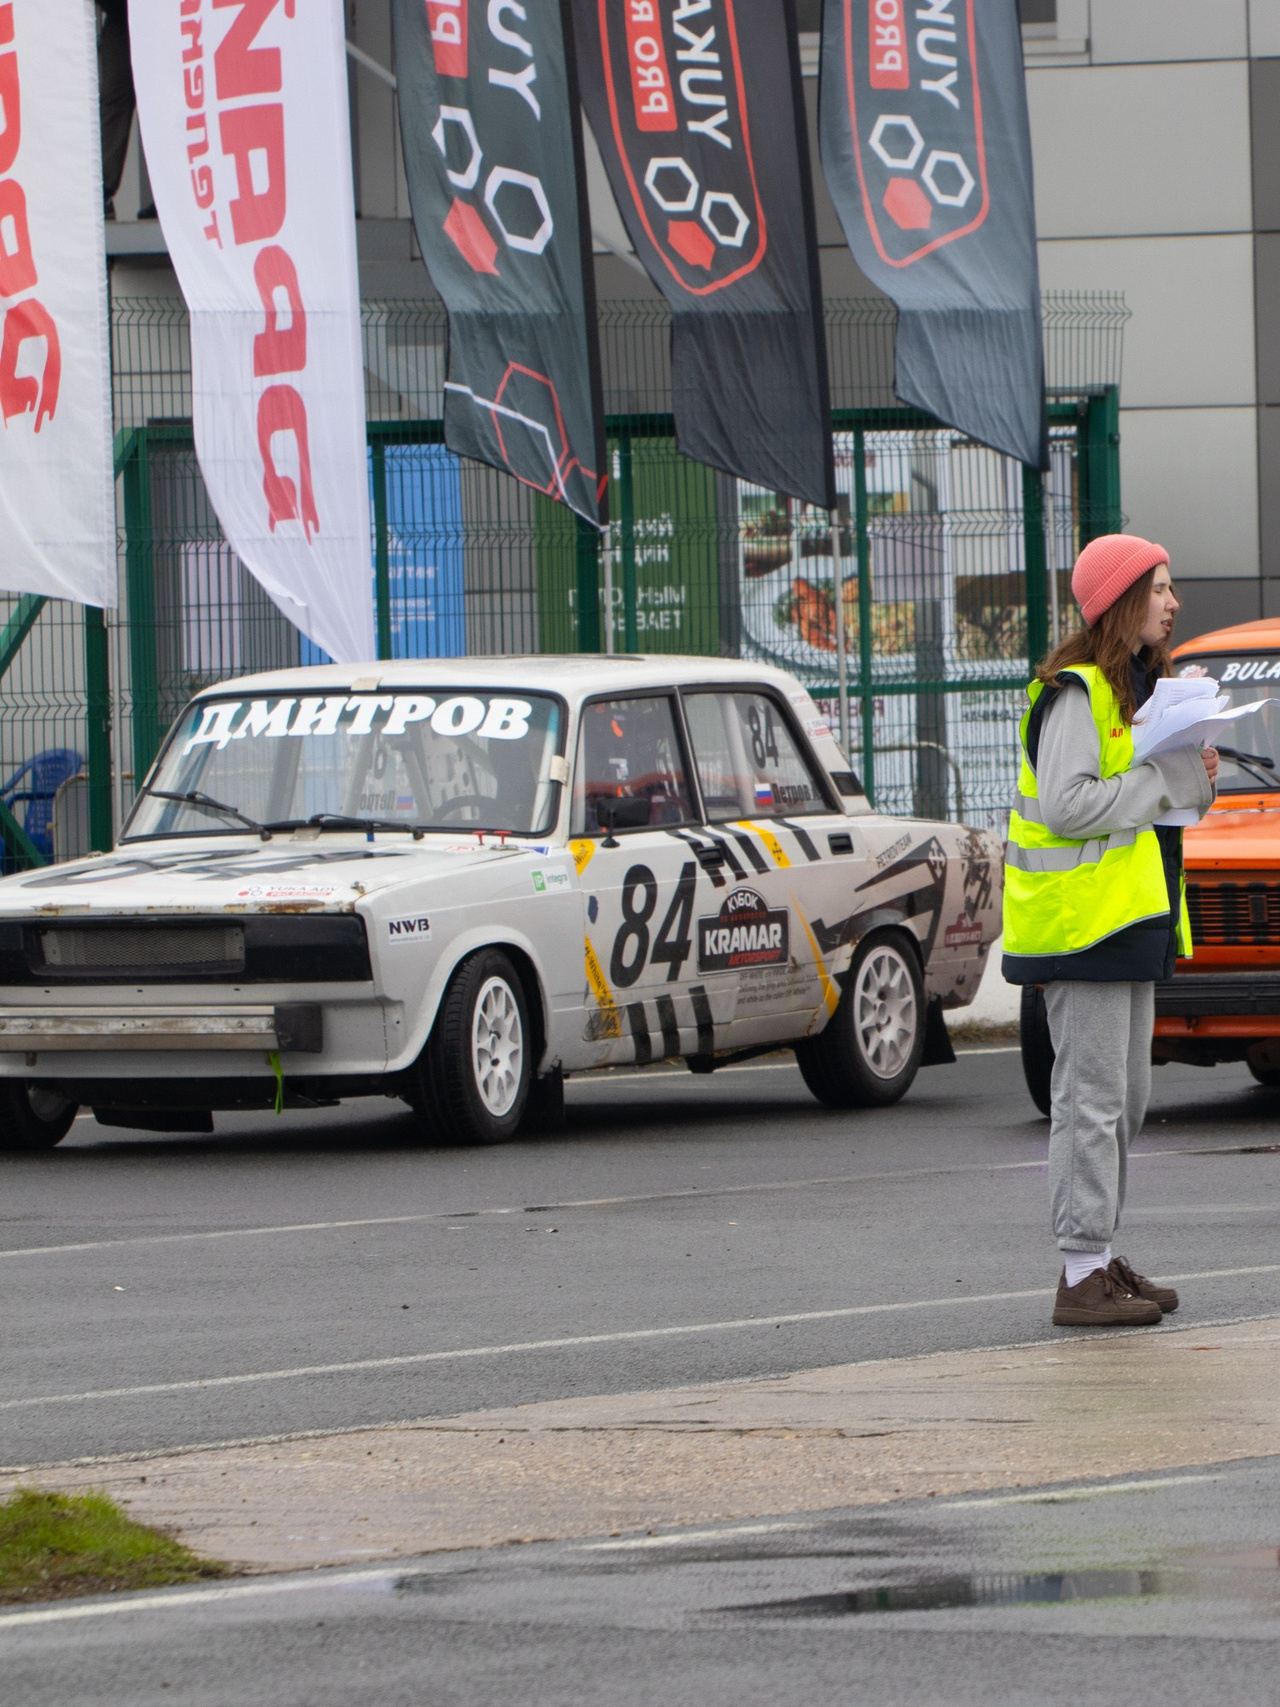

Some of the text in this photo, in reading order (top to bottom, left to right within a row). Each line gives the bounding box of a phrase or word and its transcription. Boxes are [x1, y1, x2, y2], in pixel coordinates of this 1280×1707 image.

[183, 695, 533, 756] ДМИТРОВ
[748, 705, 779, 769] 84
[388, 918, 430, 935] NWB
[609, 861, 697, 989] 84
[705, 923, 782, 956] KRAMAR
